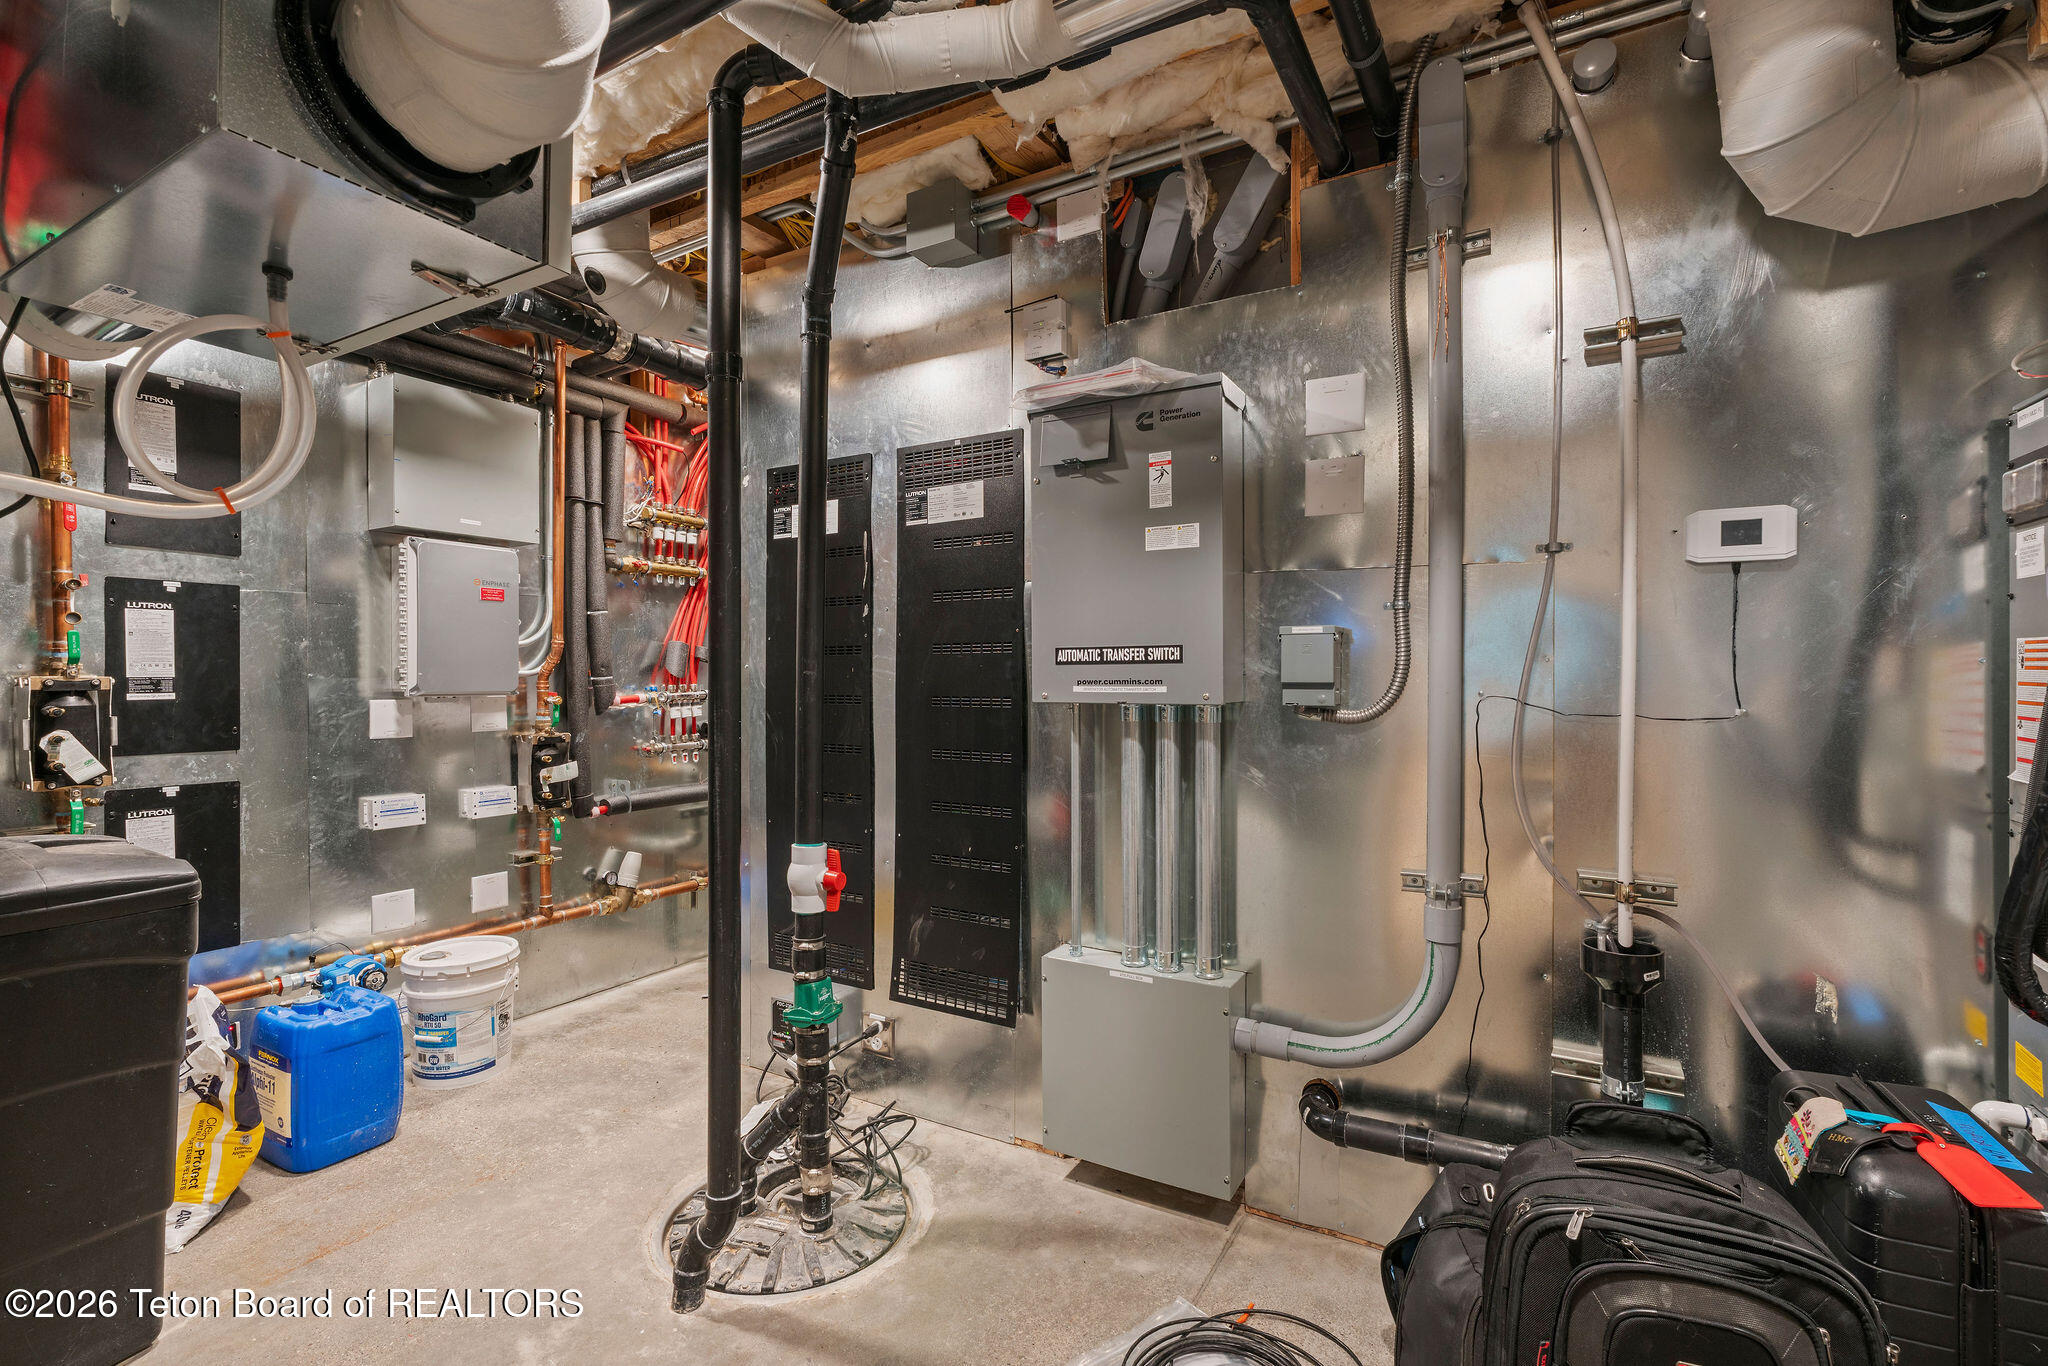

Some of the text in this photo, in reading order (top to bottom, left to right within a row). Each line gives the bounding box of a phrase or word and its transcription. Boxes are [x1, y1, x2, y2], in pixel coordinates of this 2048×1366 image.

[135, 393, 174, 406] UTRON
[1159, 406, 1183, 415] Power
[1159, 411, 1201, 422] Generation
[127, 601, 173, 610] LUTRON
[1057, 647, 1180, 663] AUTOMATIC TRANSFER SWITCH
[1076, 678, 1163, 687] power.cummins.com
[128, 808, 174, 819] LUTRON
[417, 1013, 447, 1022] RhoGard
[258, 1050, 279, 1064] FERNOX
[1827, 1133, 1853, 1144] HMC
[188, 1148, 205, 1190] Protect
